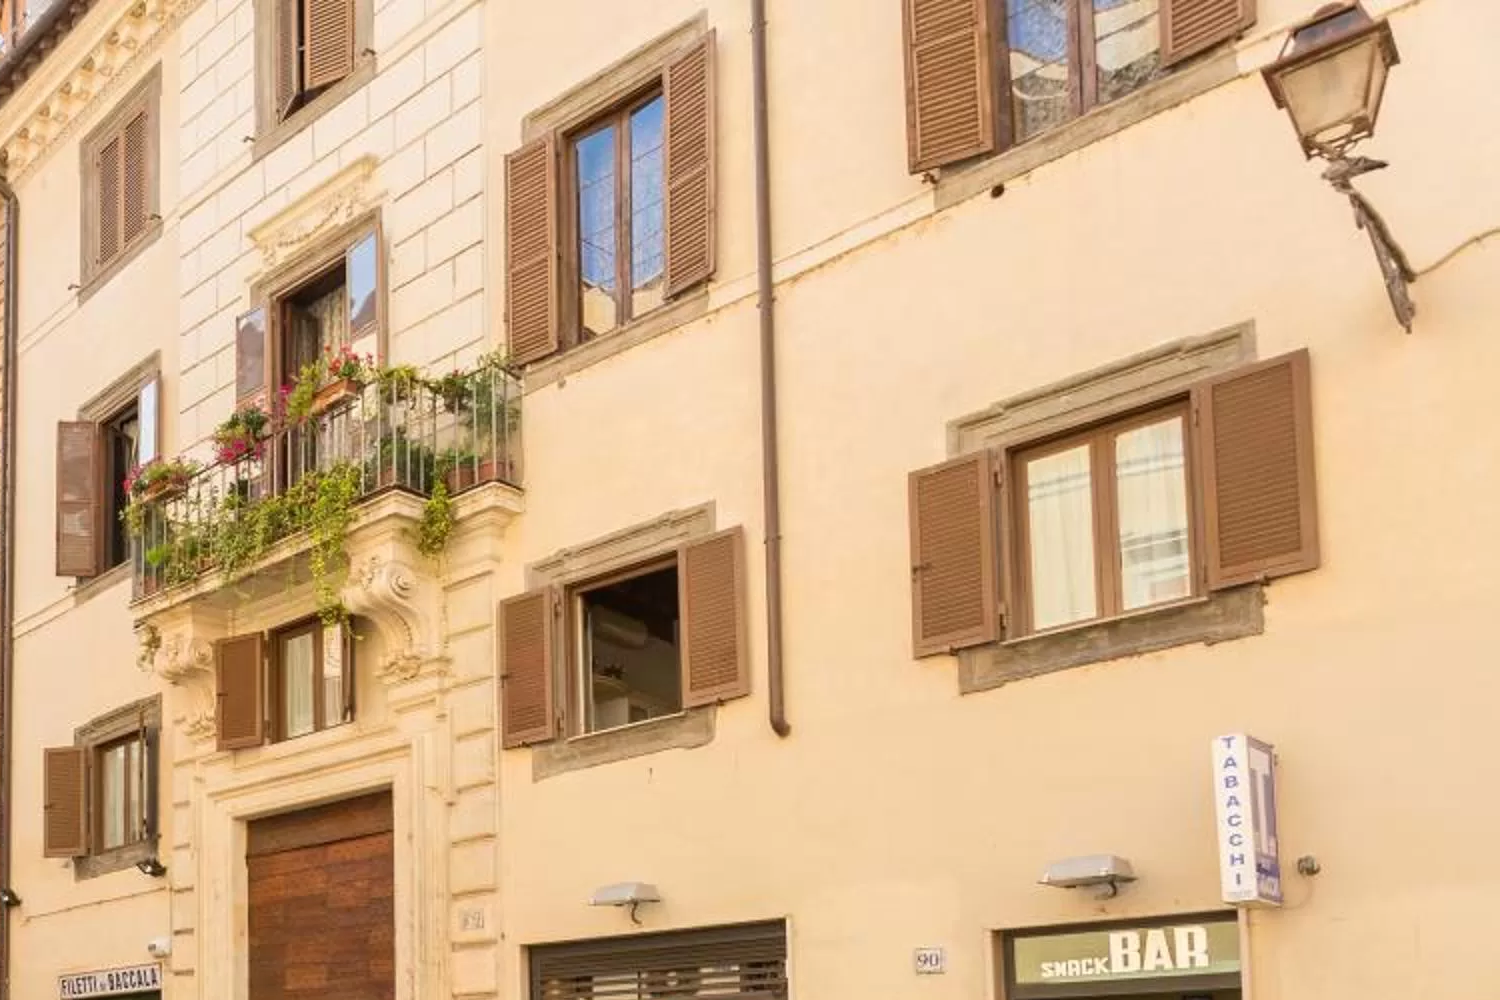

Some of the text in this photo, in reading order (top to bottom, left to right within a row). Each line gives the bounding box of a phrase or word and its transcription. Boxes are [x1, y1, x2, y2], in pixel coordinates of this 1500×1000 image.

[1221, 736, 1245, 885] TABACCHI
[917, 953, 939, 968] 90
[1041, 926, 1209, 978] SNACK BAR
[61, 975, 97, 996] FILETTI
